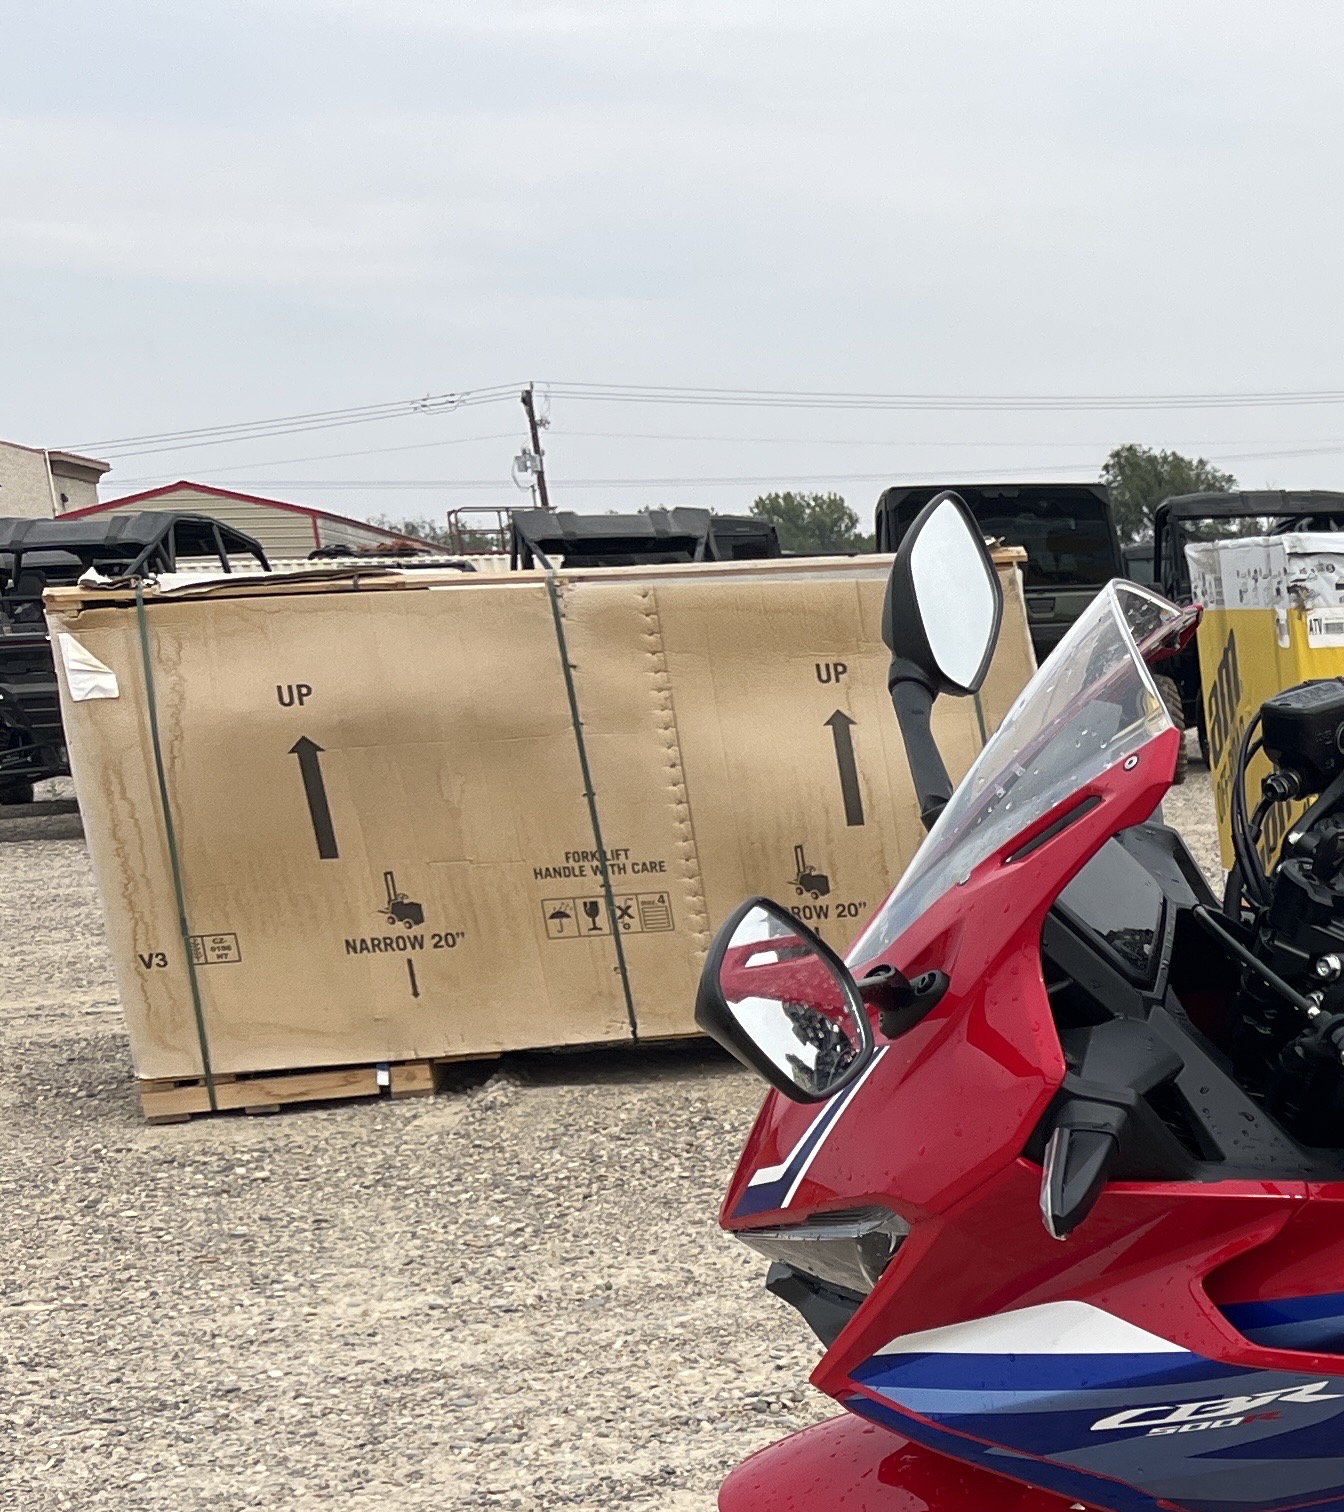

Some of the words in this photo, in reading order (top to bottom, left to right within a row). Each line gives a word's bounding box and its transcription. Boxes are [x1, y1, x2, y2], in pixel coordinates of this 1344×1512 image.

[1309, 618, 1322, 635] ATV
[815, 662, 848, 684] UP
[276, 683, 313, 707] UP
[533, 864, 587, 880] HANDLE
[591, 862, 627, 877] WTH
[632, 860, 667, 874] CARE
[784, 904, 829, 920] ROW
[345, 933, 425, 955] NARROW
[138, 952, 168, 969] V3
[1146, 1411, 1282, 1437] 500R
